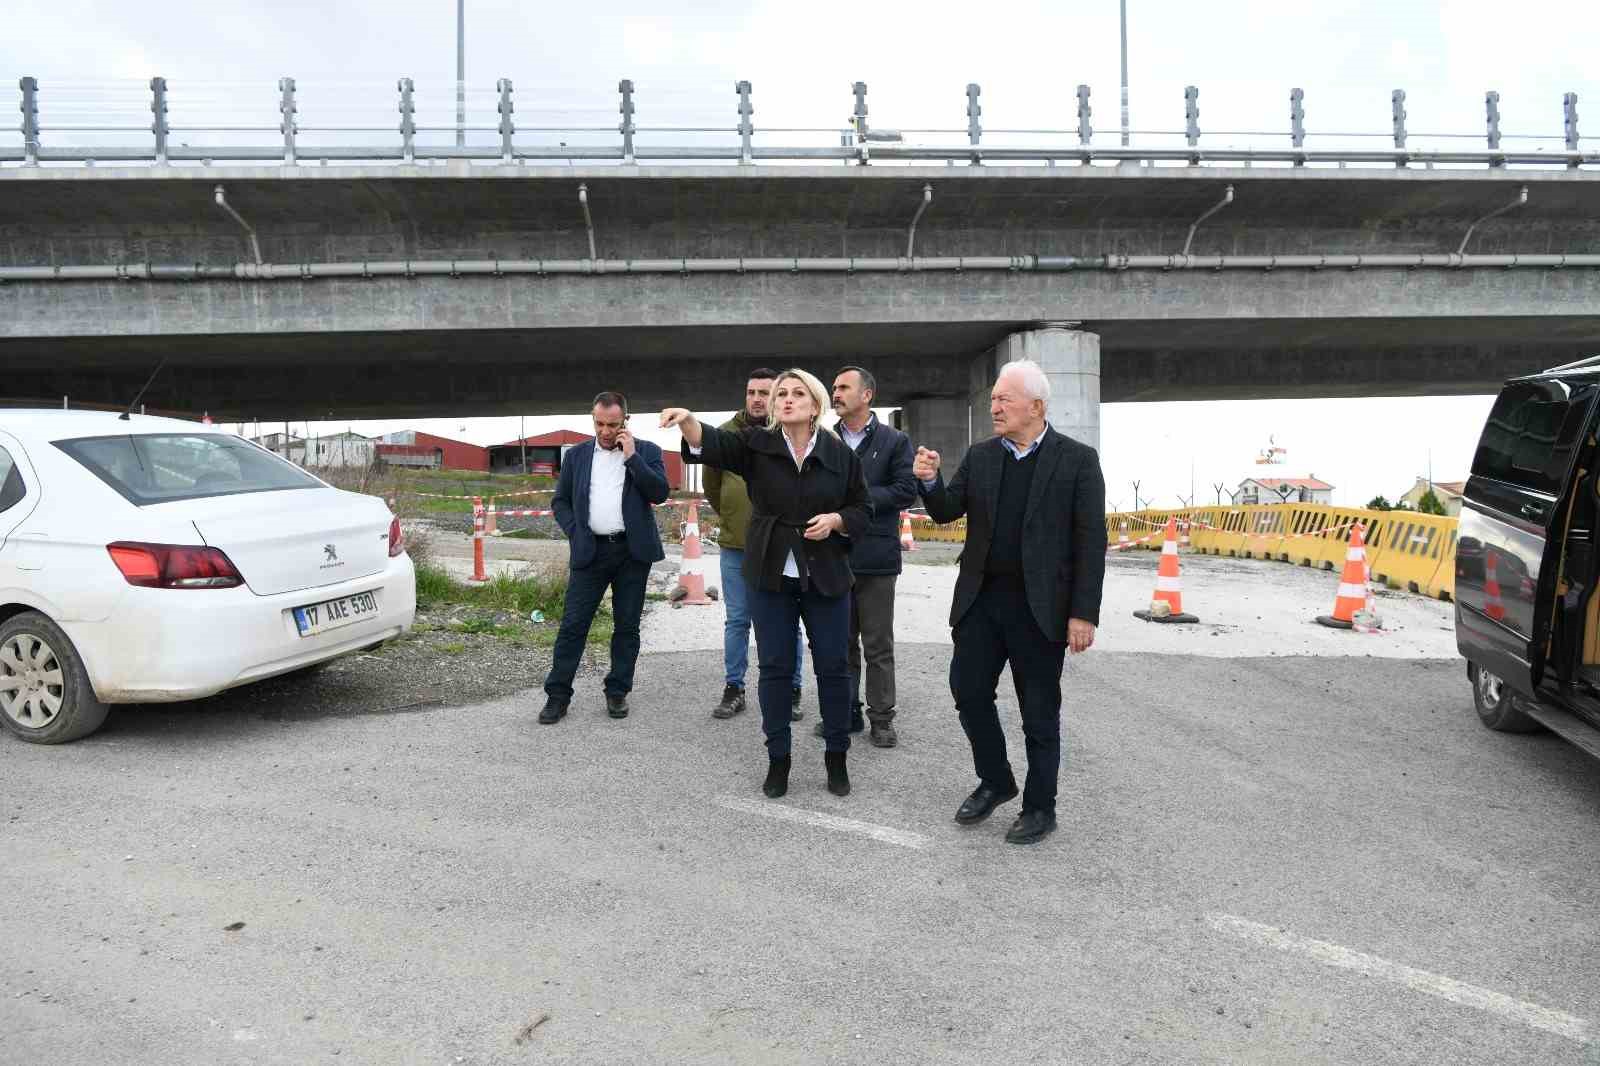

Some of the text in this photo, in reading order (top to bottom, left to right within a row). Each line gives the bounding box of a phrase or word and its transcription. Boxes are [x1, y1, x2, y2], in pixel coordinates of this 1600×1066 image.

[305, 594, 373, 626] 17 AAE 530
